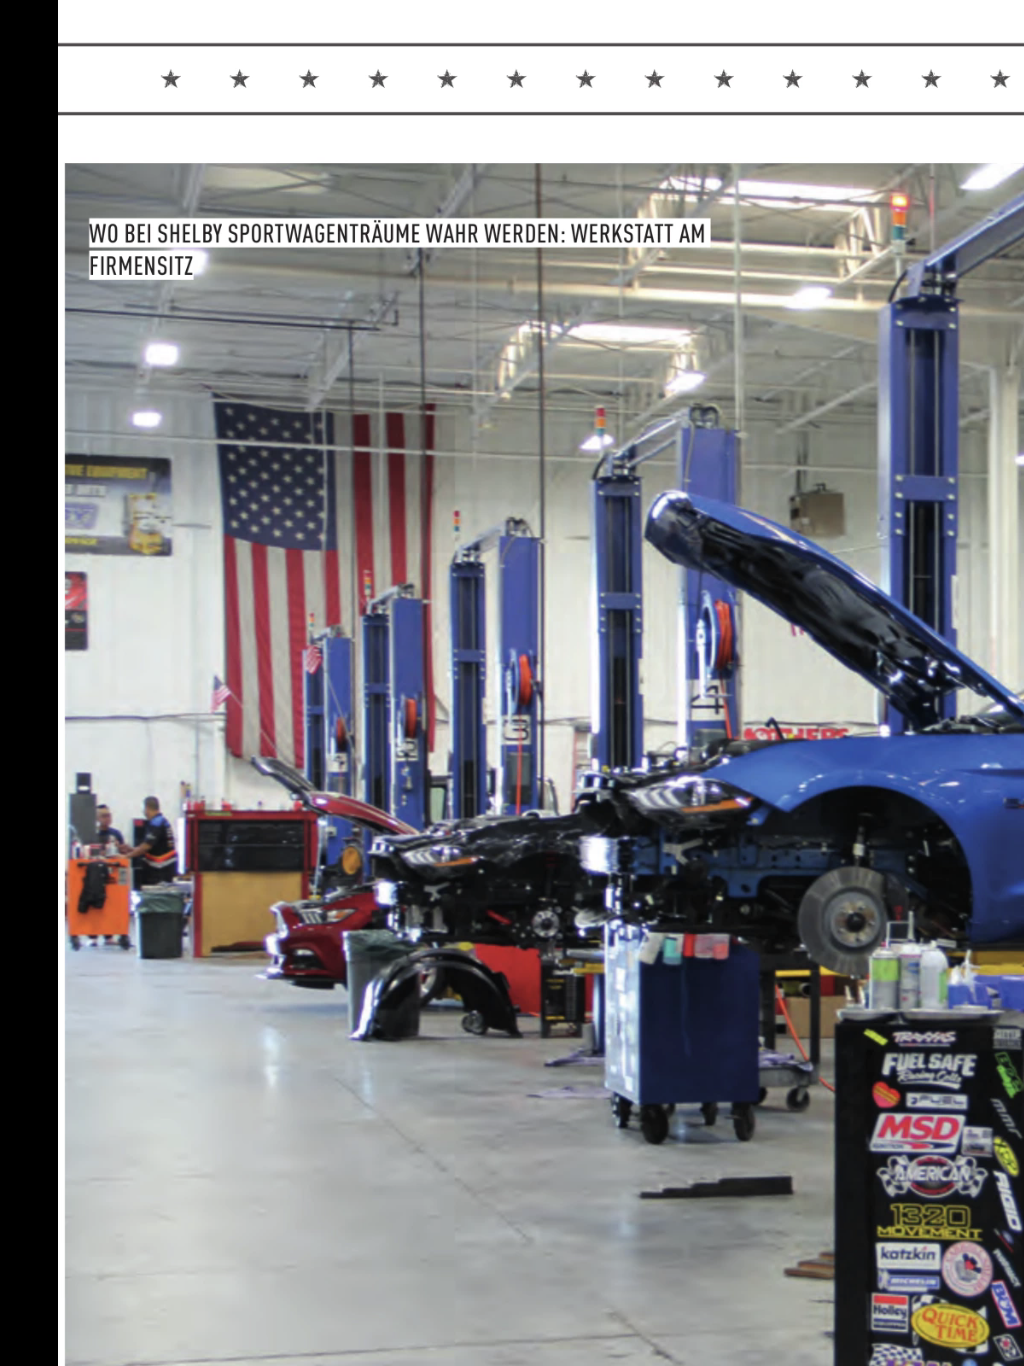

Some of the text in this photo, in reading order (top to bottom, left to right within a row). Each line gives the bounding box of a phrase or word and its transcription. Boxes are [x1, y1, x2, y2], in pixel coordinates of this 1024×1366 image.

[882, 1053, 926, 1076] FUEL
[928, 1053, 978, 1076] SAFE
[877, 1115, 960, 1140] MSD
[893, 1166, 972, 1181] AMERICAN
[890, 1203, 971, 1228] 1320
[876, 1226, 983, 1240] MOVEMENT
[880, 1246, 936, 1261] katzkin
[873, 1304, 907, 1319] Holley
[921, 1307, 979, 1329] QUICK
[935, 1324, 979, 1342] TIME
